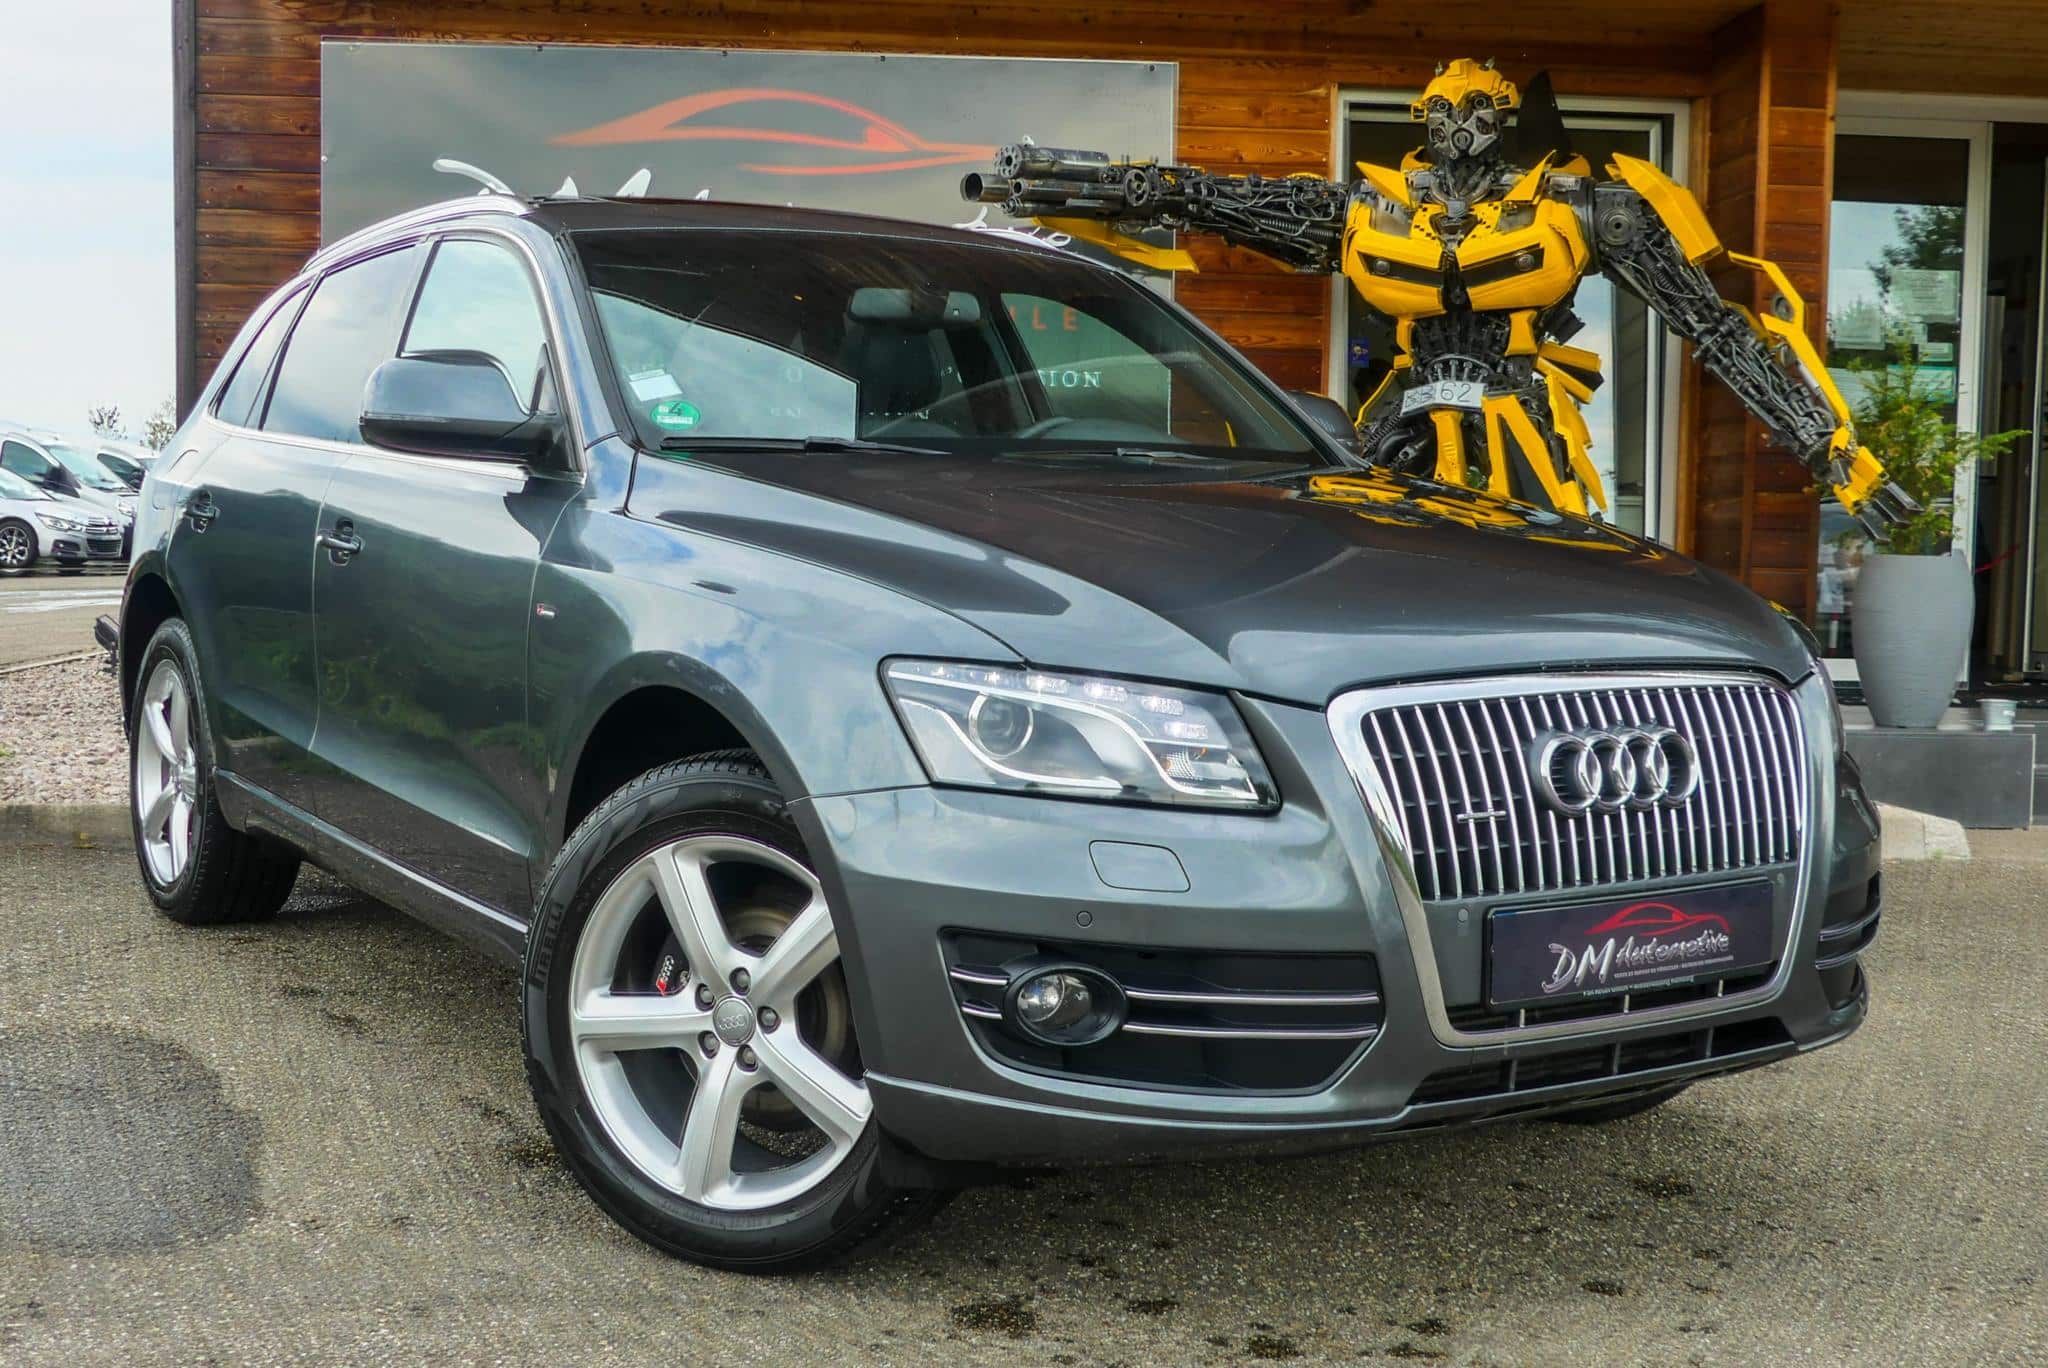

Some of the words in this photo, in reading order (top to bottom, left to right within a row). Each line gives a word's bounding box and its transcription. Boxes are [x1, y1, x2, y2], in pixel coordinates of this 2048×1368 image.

[1440, 381, 1472, 402] 62
[1541, 938, 1615, 993] DM
[1616, 929, 1729, 967] Automotive
